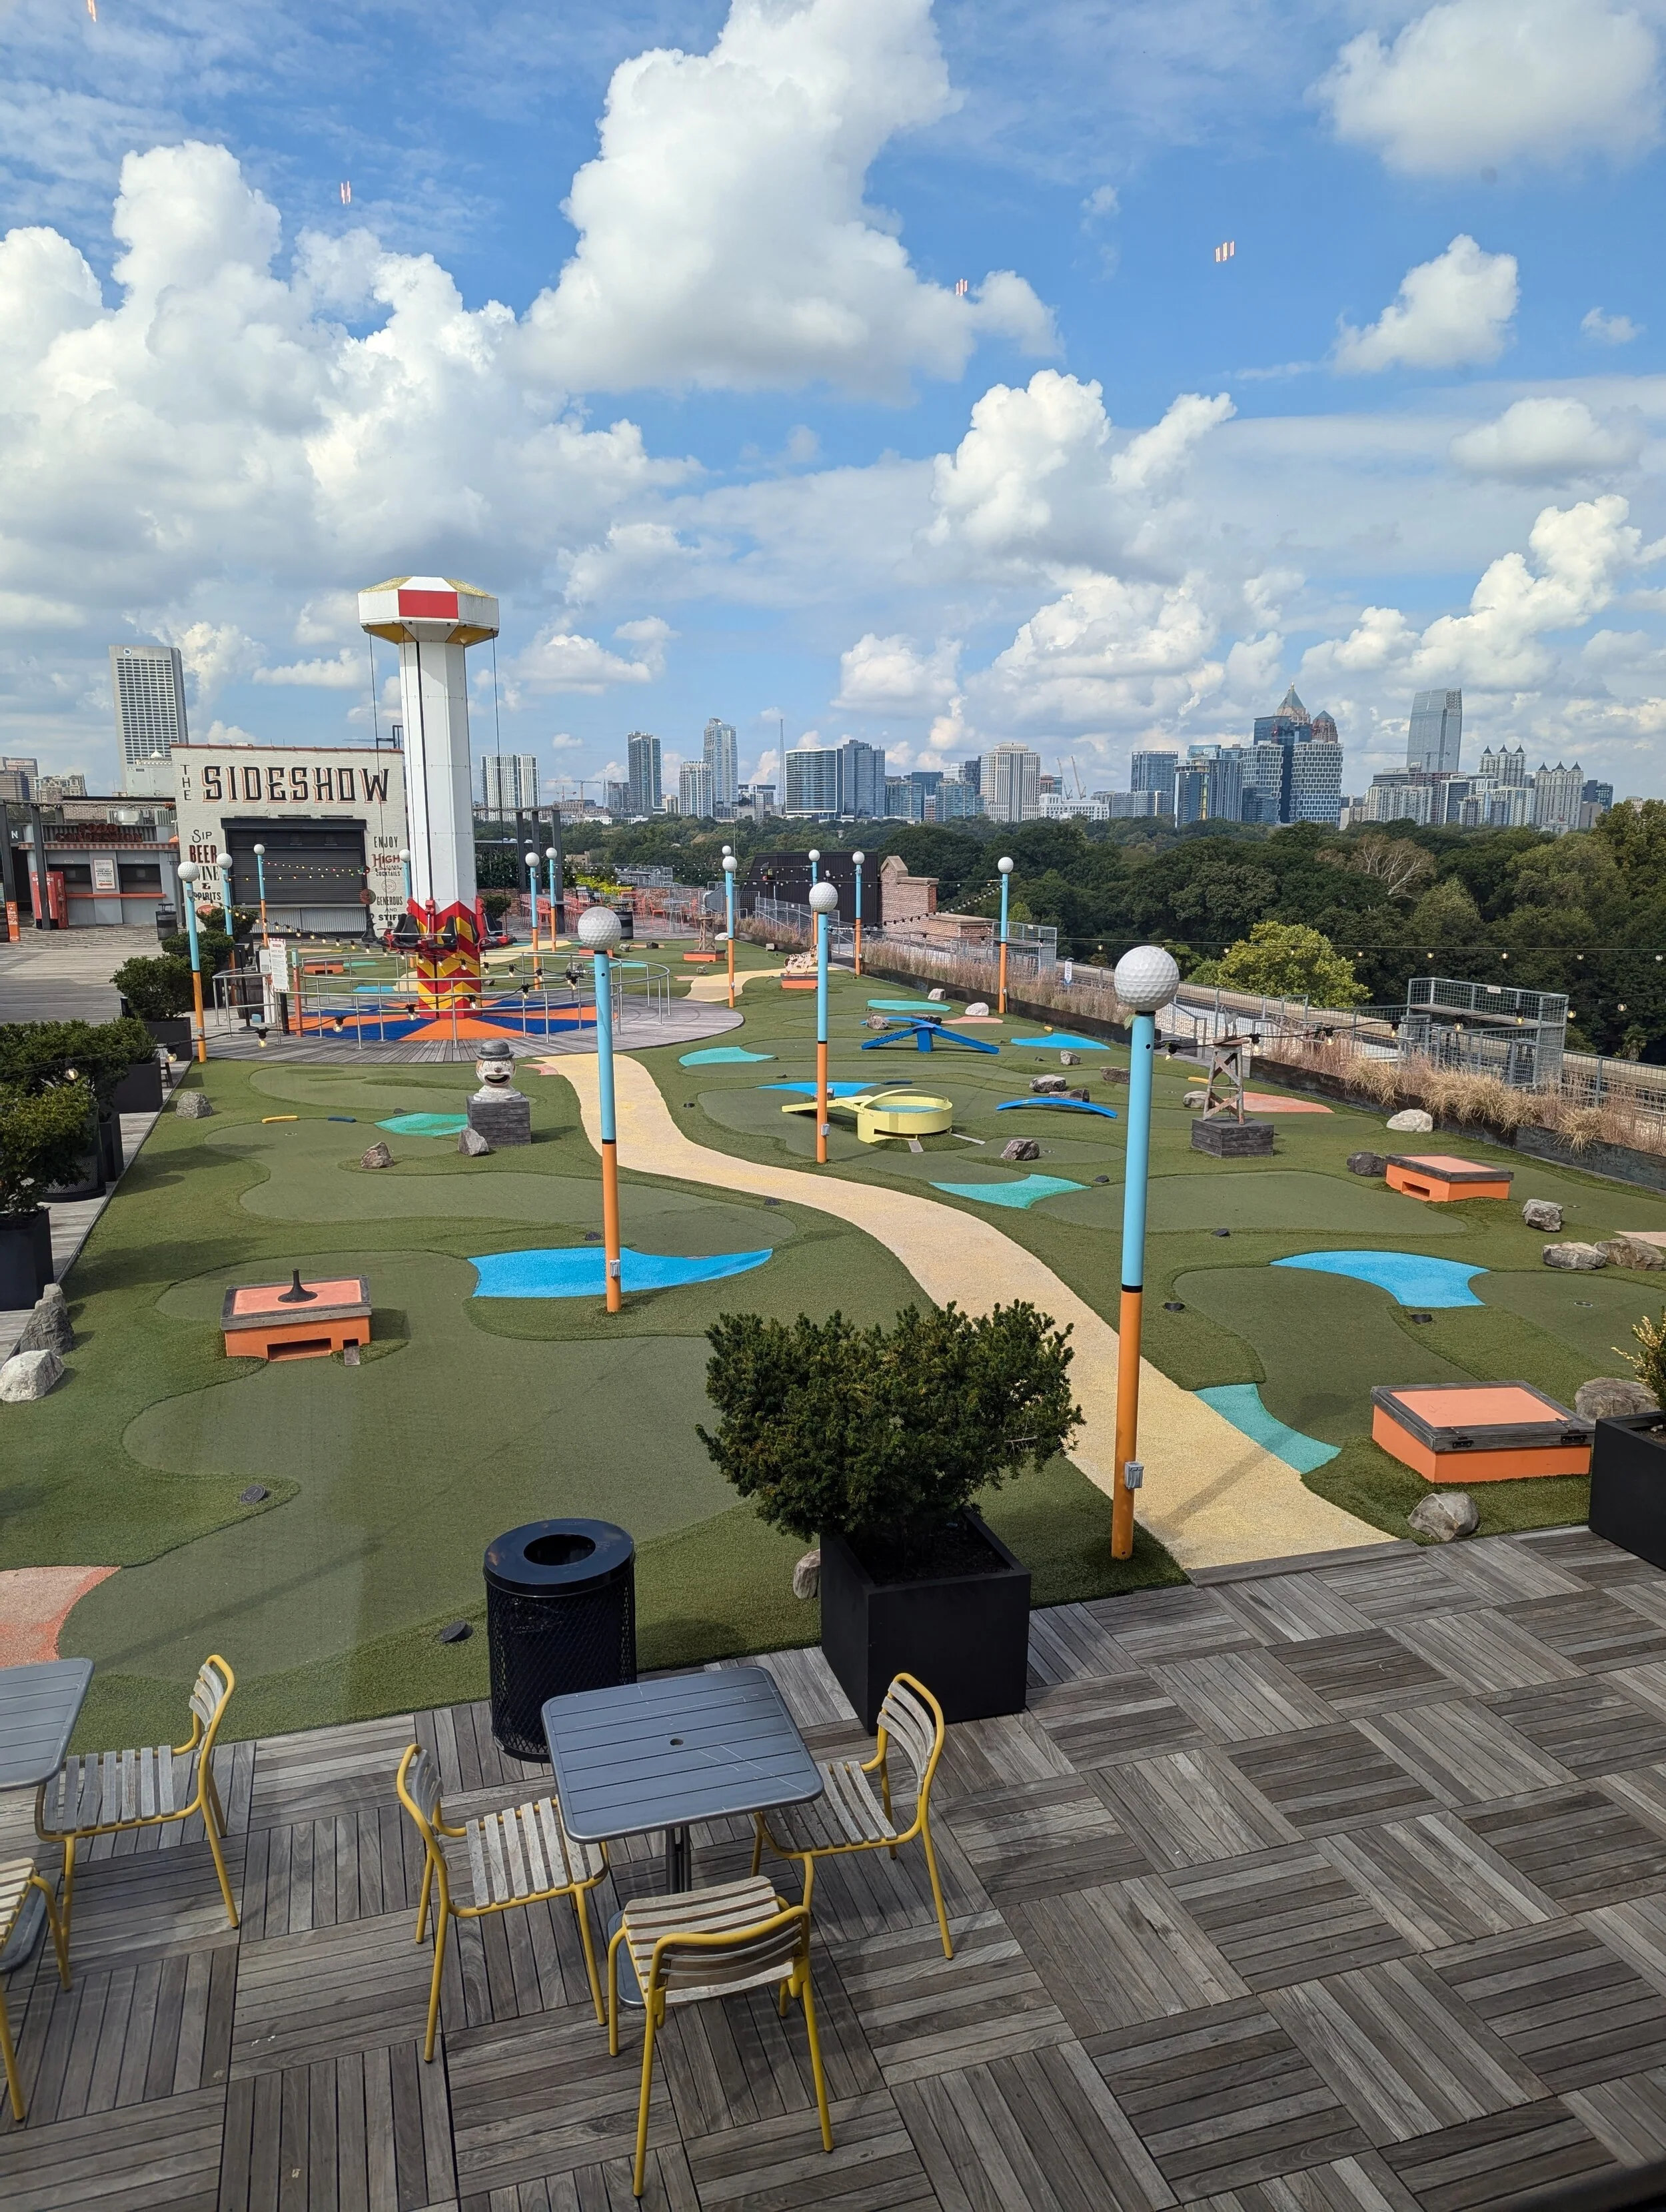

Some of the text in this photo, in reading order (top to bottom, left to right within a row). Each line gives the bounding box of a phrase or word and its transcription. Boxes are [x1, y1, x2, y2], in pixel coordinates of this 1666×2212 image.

[180, 764, 191, 800] THE
[202, 766, 389, 804] SIDESHOW
[374, 836, 398, 848] ENJOY
[189, 845, 217, 863] BEER
[199, 866, 220, 881] INE
[377, 896, 403, 905] GENEROUS
